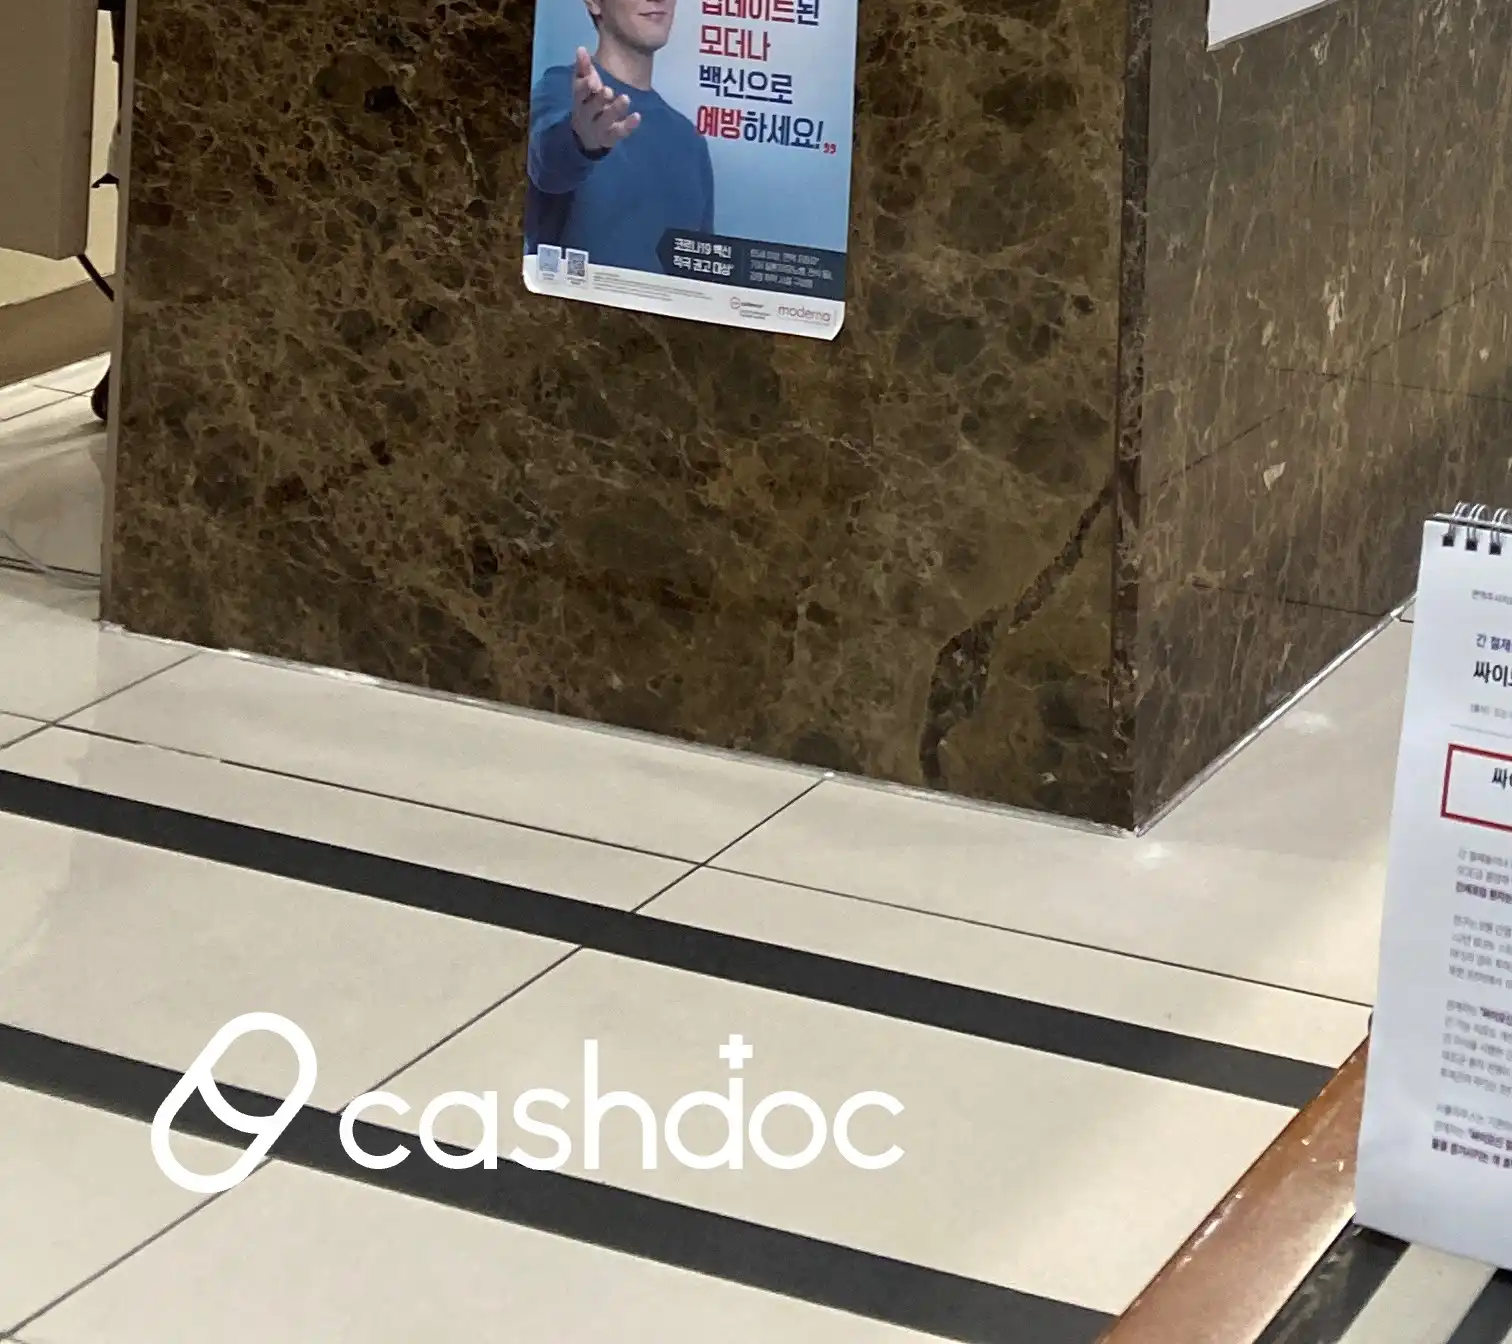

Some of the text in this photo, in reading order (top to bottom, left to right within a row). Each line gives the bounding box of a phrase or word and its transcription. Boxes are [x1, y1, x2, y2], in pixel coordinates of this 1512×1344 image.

[699, 25, 771, 63] 모더나
[698, 64, 794, 107] 백신으로
[674, 236, 733, 260] 코로나19 백신
[673, 254, 692, 271] 적극
[692, 258, 712, 273] 권고
[1476, 633, 1488, 649] 간
